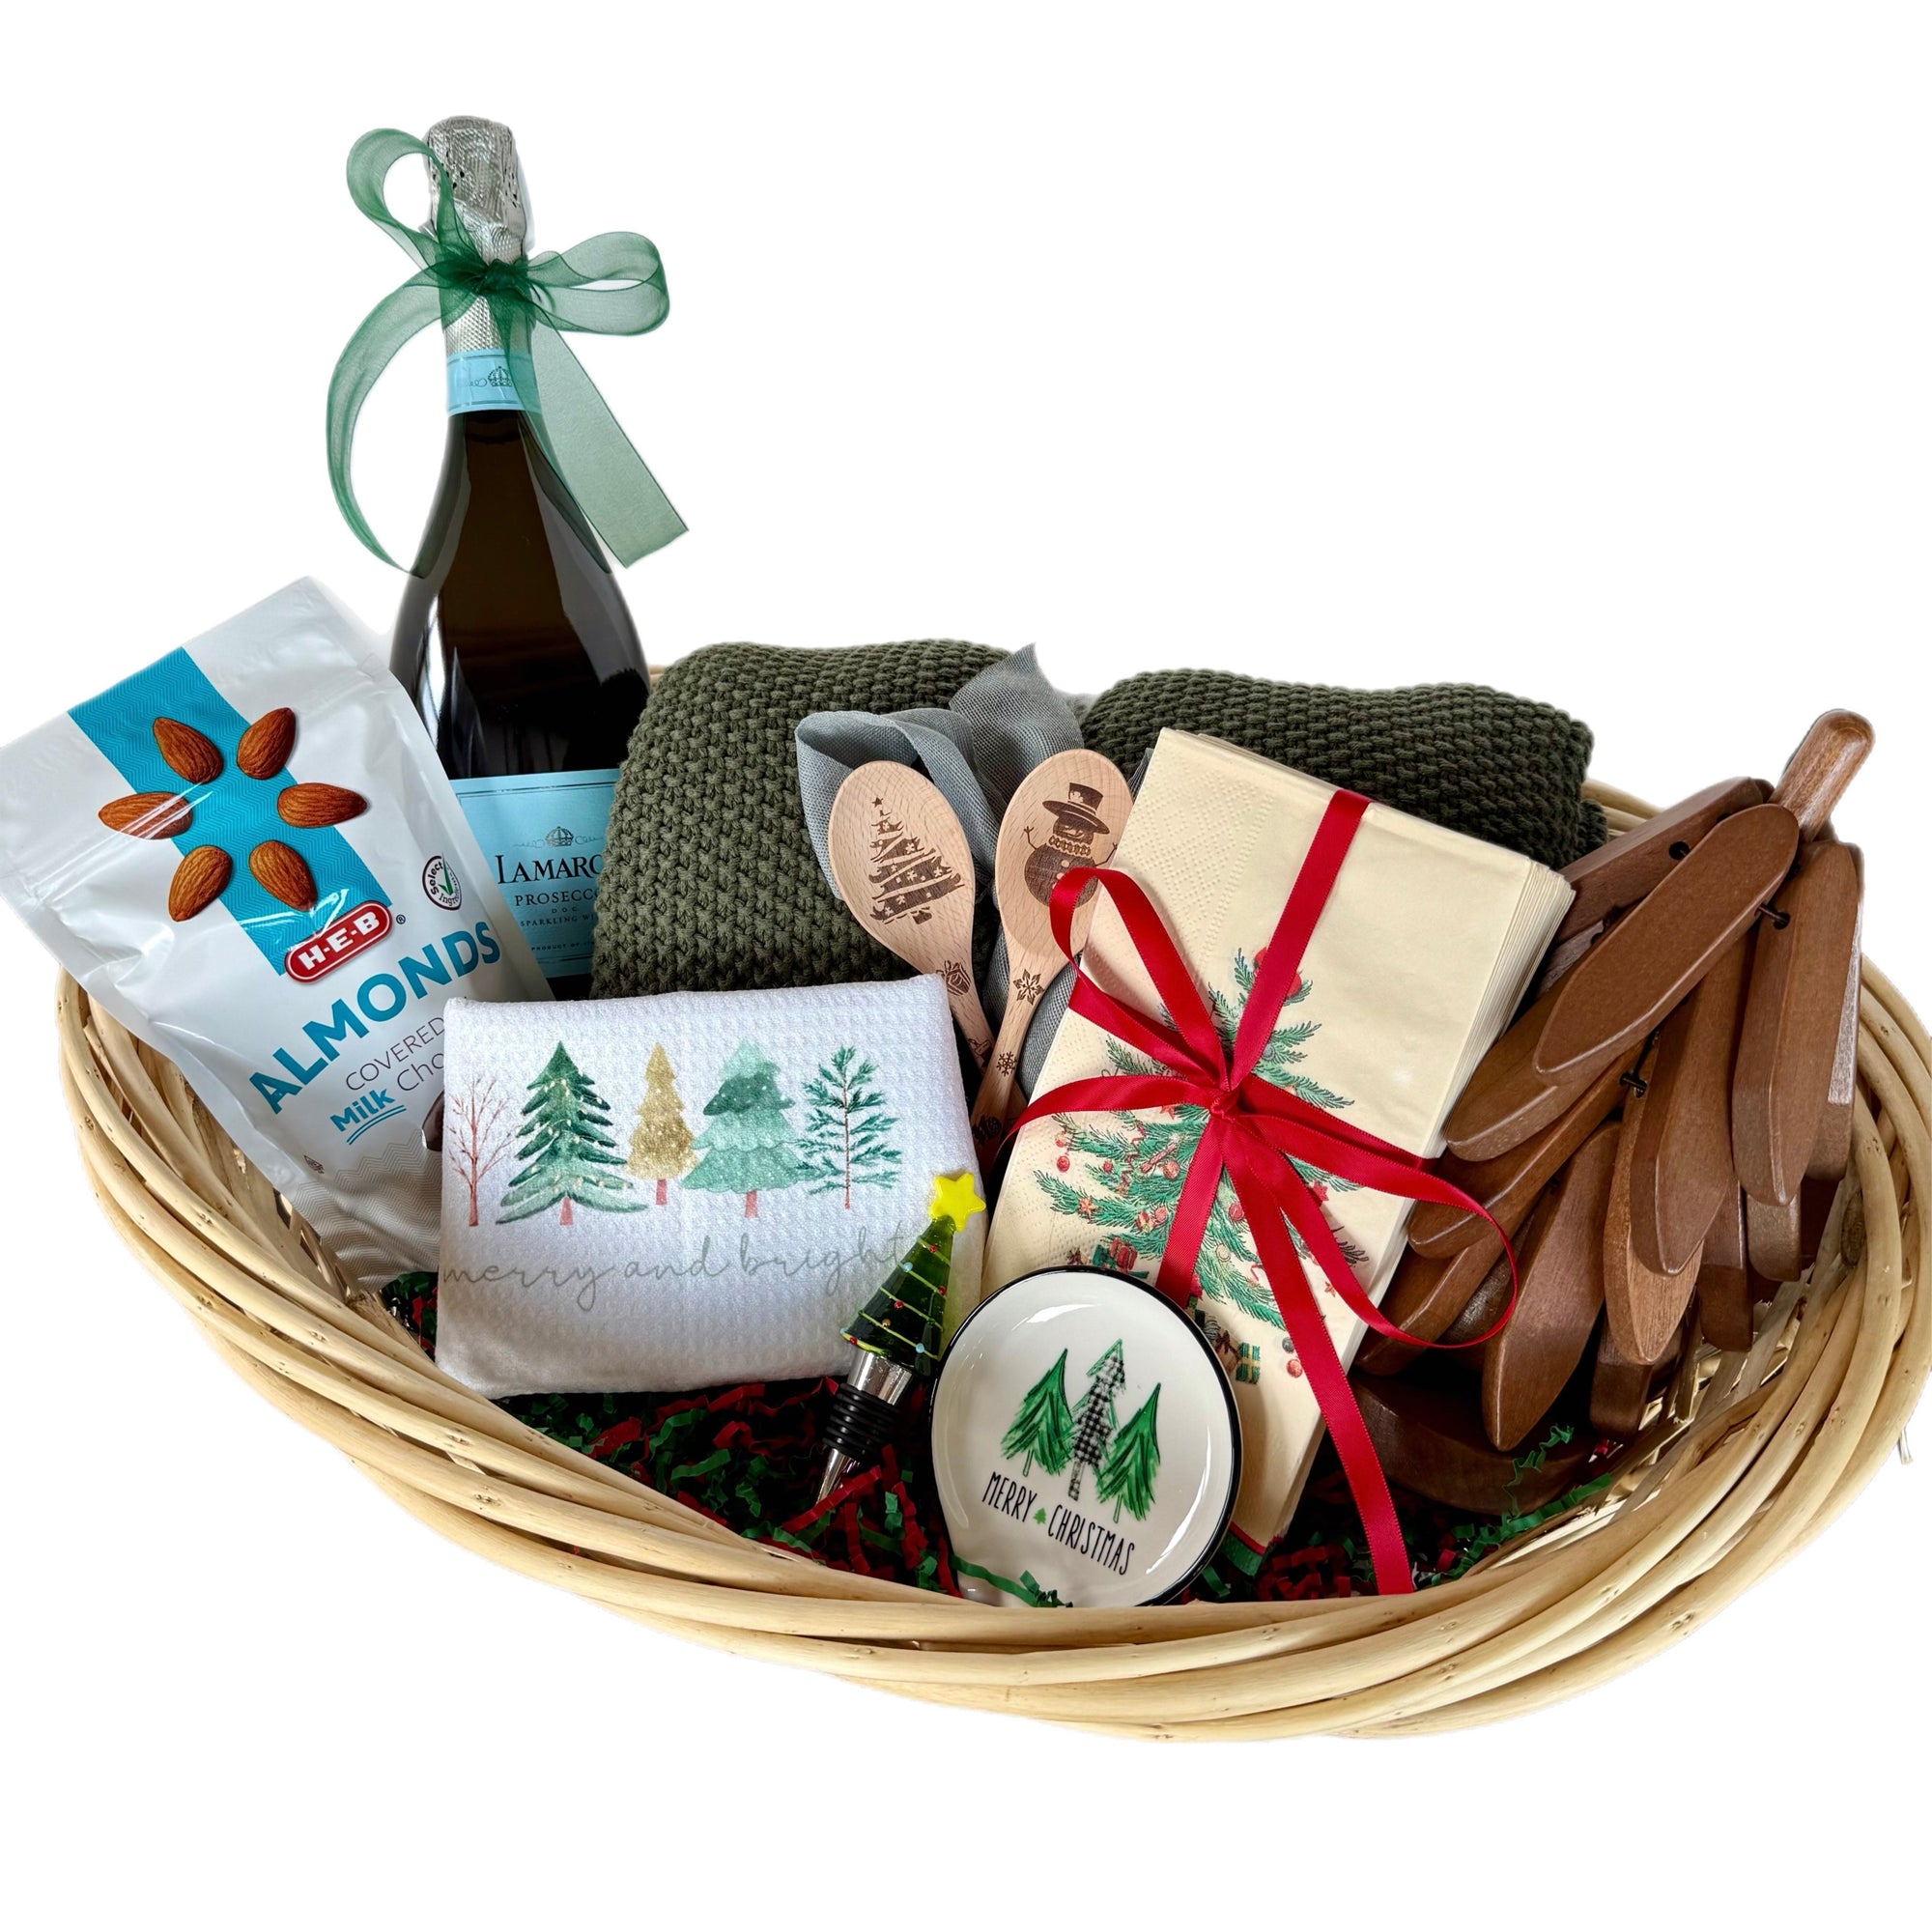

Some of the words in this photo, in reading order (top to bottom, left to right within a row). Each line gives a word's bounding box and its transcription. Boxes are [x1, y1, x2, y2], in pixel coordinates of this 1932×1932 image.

[428, 861, 443, 895] Select
[298, 911, 380, 971] H-E-B
[521, 915, 578, 927] SPARKLING
[249, 922, 500, 1115] ALMONDS
[346, 1017, 444, 1091] COVERED
[329, 1089, 395, 1132] Milk
[443, 1264, 615, 1312] merry
[625, 1235, 730, 1282] and
[740, 1220, 904, 1296] bright
[981, 1471, 1037, 1522] MERRY
[1048, 1504, 1135, 1576] CHRISTMAS
